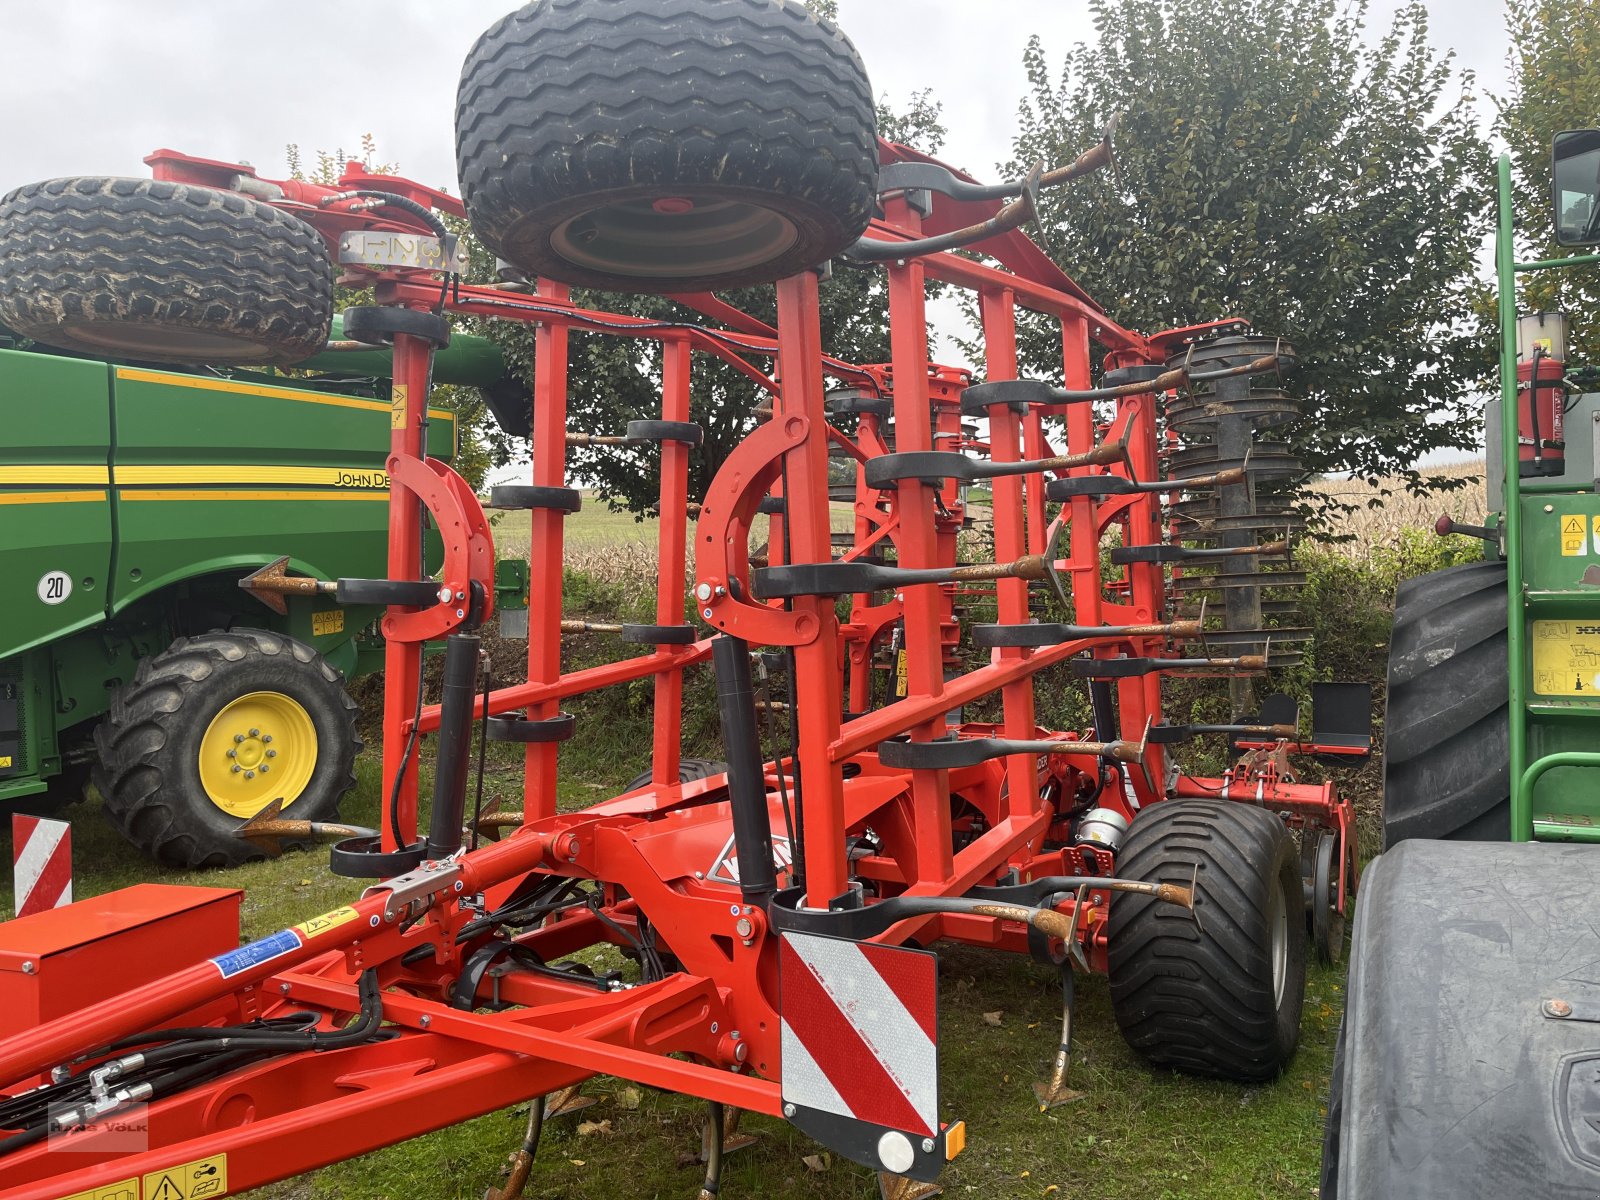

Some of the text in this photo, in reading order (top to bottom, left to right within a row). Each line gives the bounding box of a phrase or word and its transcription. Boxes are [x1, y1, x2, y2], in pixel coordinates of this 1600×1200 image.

[393, 238, 415, 253] 2
[422, 241, 441, 258] 3
[334, 471, 391, 487] JOHN DE
[46, 577, 64, 599] 20
